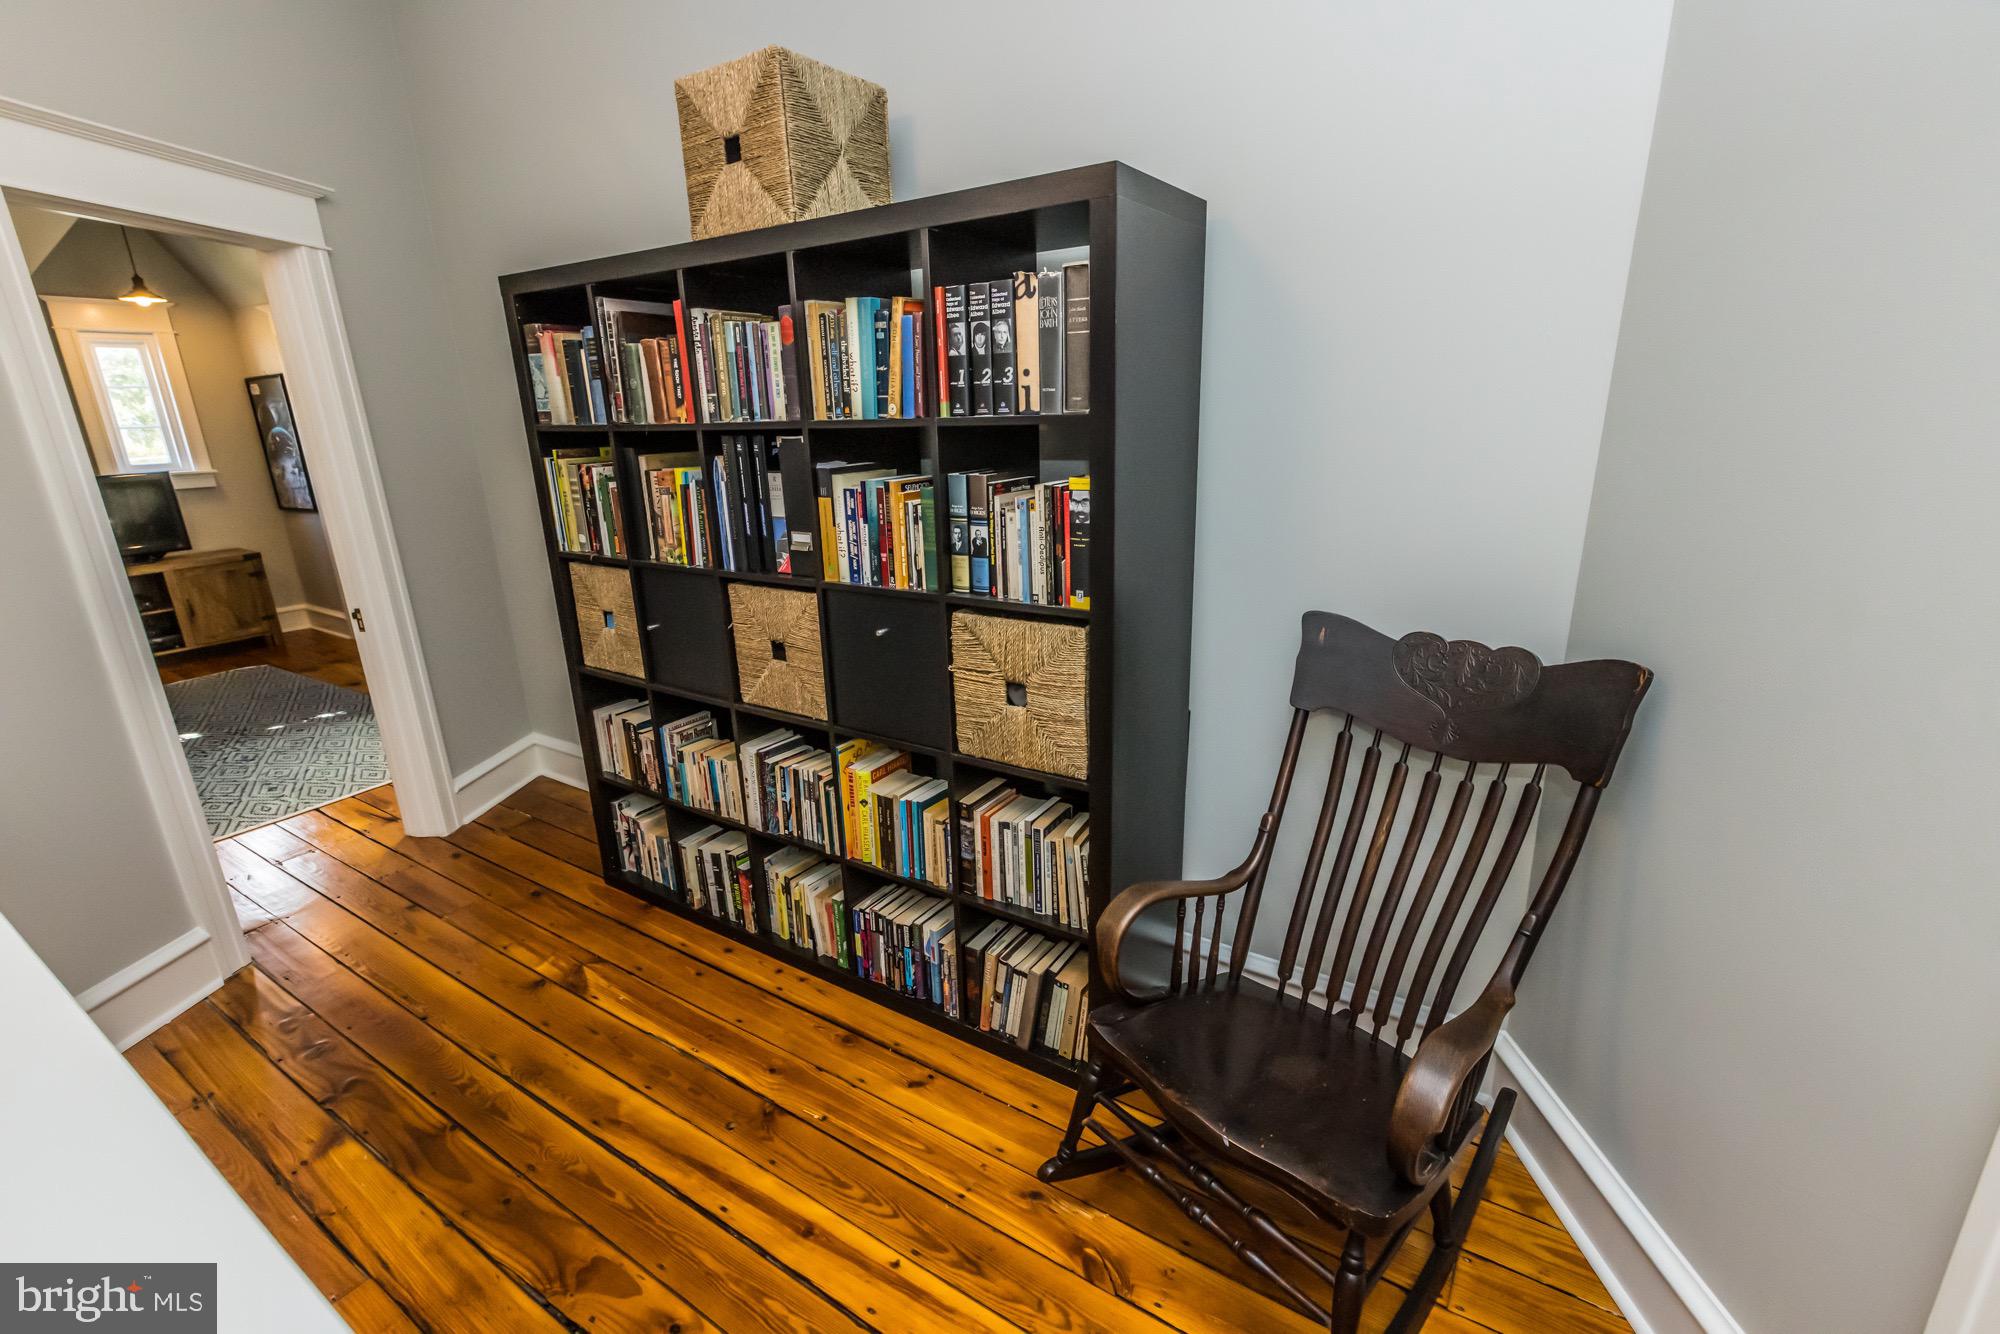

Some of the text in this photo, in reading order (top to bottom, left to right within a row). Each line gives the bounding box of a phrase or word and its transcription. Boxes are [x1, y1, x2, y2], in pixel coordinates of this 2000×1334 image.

[841, 353, 849, 380] divided
[849, 352, 858, 379] what
[1003, 367, 1014, 382] 3
[958, 369, 965, 384] 1
[982, 368, 991, 384] 2
[843, 380, 851, 394] self
[836, 522, 845, 547] what
[1038, 526, 1046, 575] Anti-Oedipus
